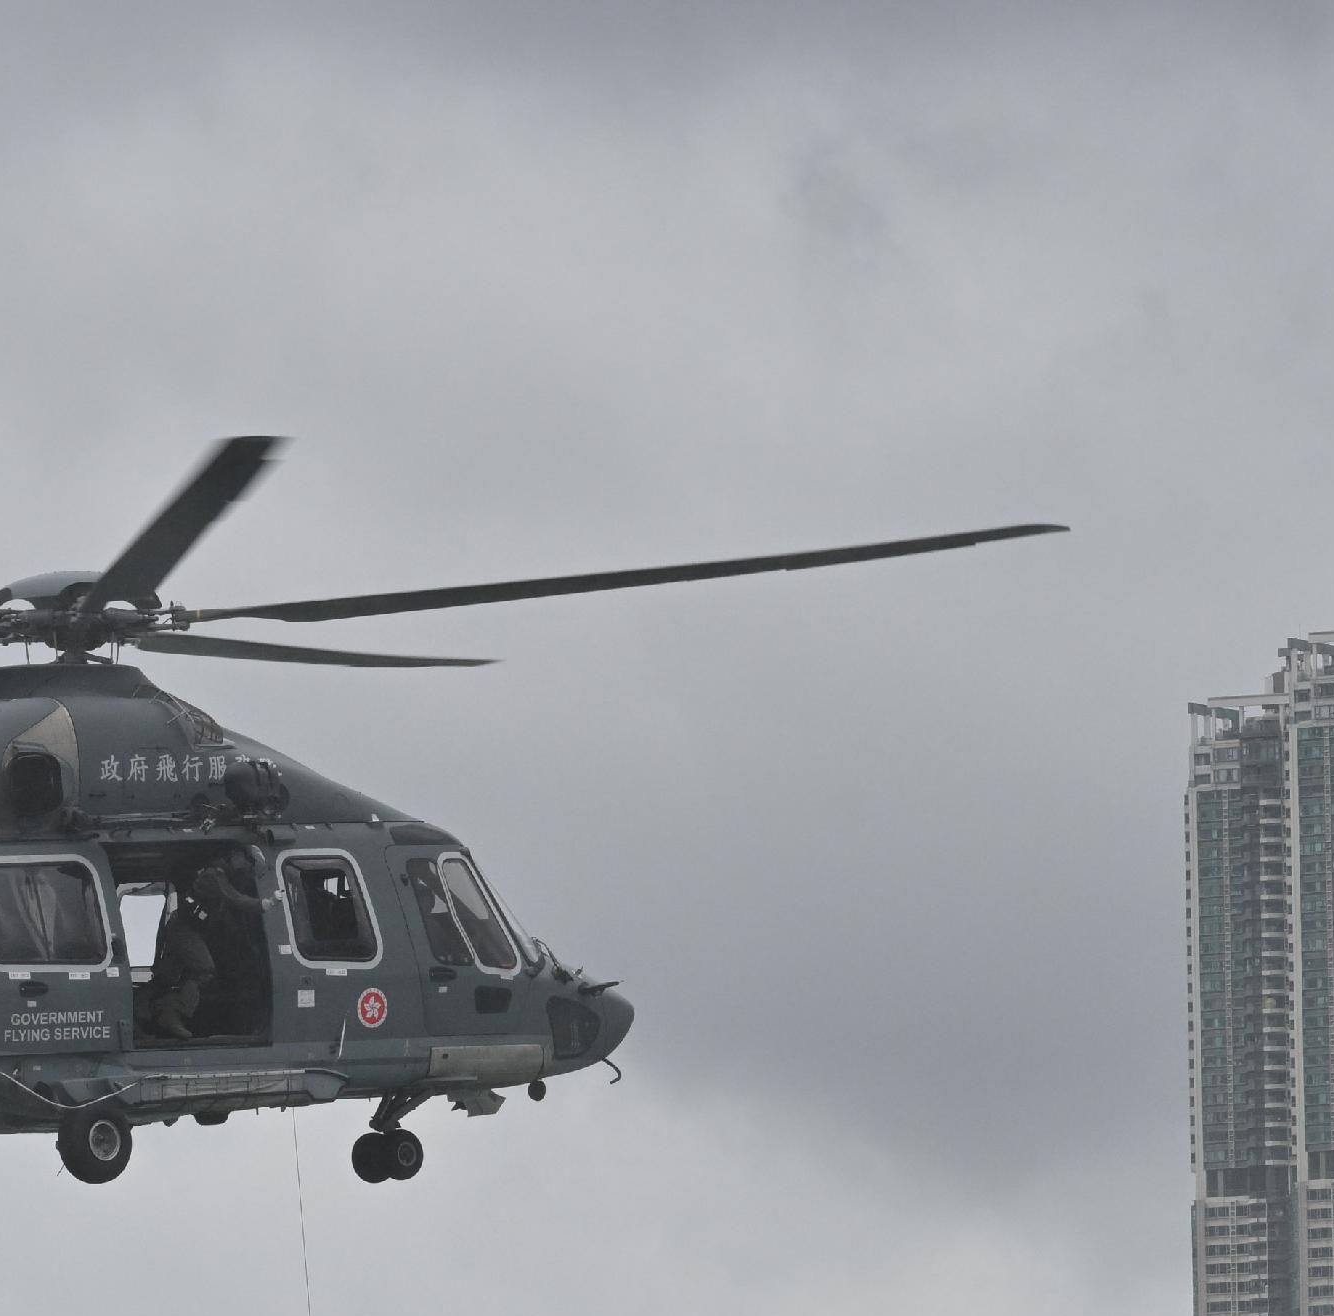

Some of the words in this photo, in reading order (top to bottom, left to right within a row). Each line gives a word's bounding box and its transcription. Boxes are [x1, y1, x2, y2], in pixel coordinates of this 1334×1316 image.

[100, 754, 283, 783] 政府飛行服
[10, 1010, 105, 1026] GOVERNMENT
[4, 1028, 51, 1042] FLYING
[53, 1026, 111, 1041] SERVICE
